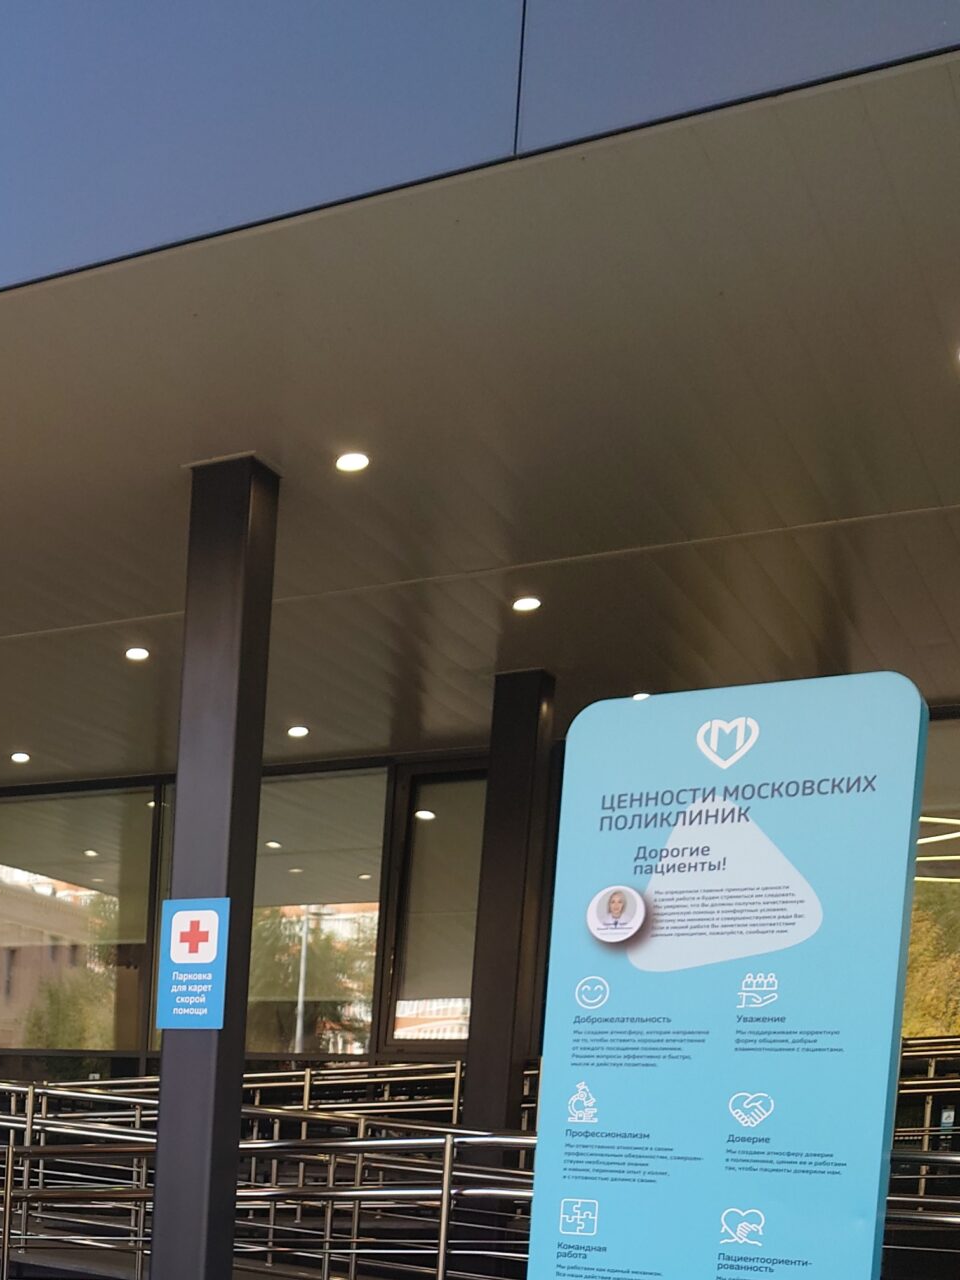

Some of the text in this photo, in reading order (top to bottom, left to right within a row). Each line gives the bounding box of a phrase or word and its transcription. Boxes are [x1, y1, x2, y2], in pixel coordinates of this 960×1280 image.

[601, 774, 878, 811] ЦЕННОСТИ МОСКОВСКИХ
[599, 806, 751, 832] ПОЛИКЛИНИК
[633, 844, 711, 862] Дорогие
[633, 857, 727, 876] пациенты!
[172, 971, 213, 983] Парковка
[171, 984, 213, 994] для карет
[176, 994, 206, 1005] скорой
[172, 1007, 208, 1016] помощи
[573, 1016, 672, 1024] Доброжелательность
[736, 1015, 786, 1023] Уважение
[565, 1129, 650, 1139] Профессионализм
[727, 1134, 771, 1144] Доверие
[557, 1242, 607, 1252] Командная
[556, 1251, 587, 1259] работа
[717, 1253, 812, 1266] Пациентоориенти-
[716, 1262, 775, 1273] рованность
